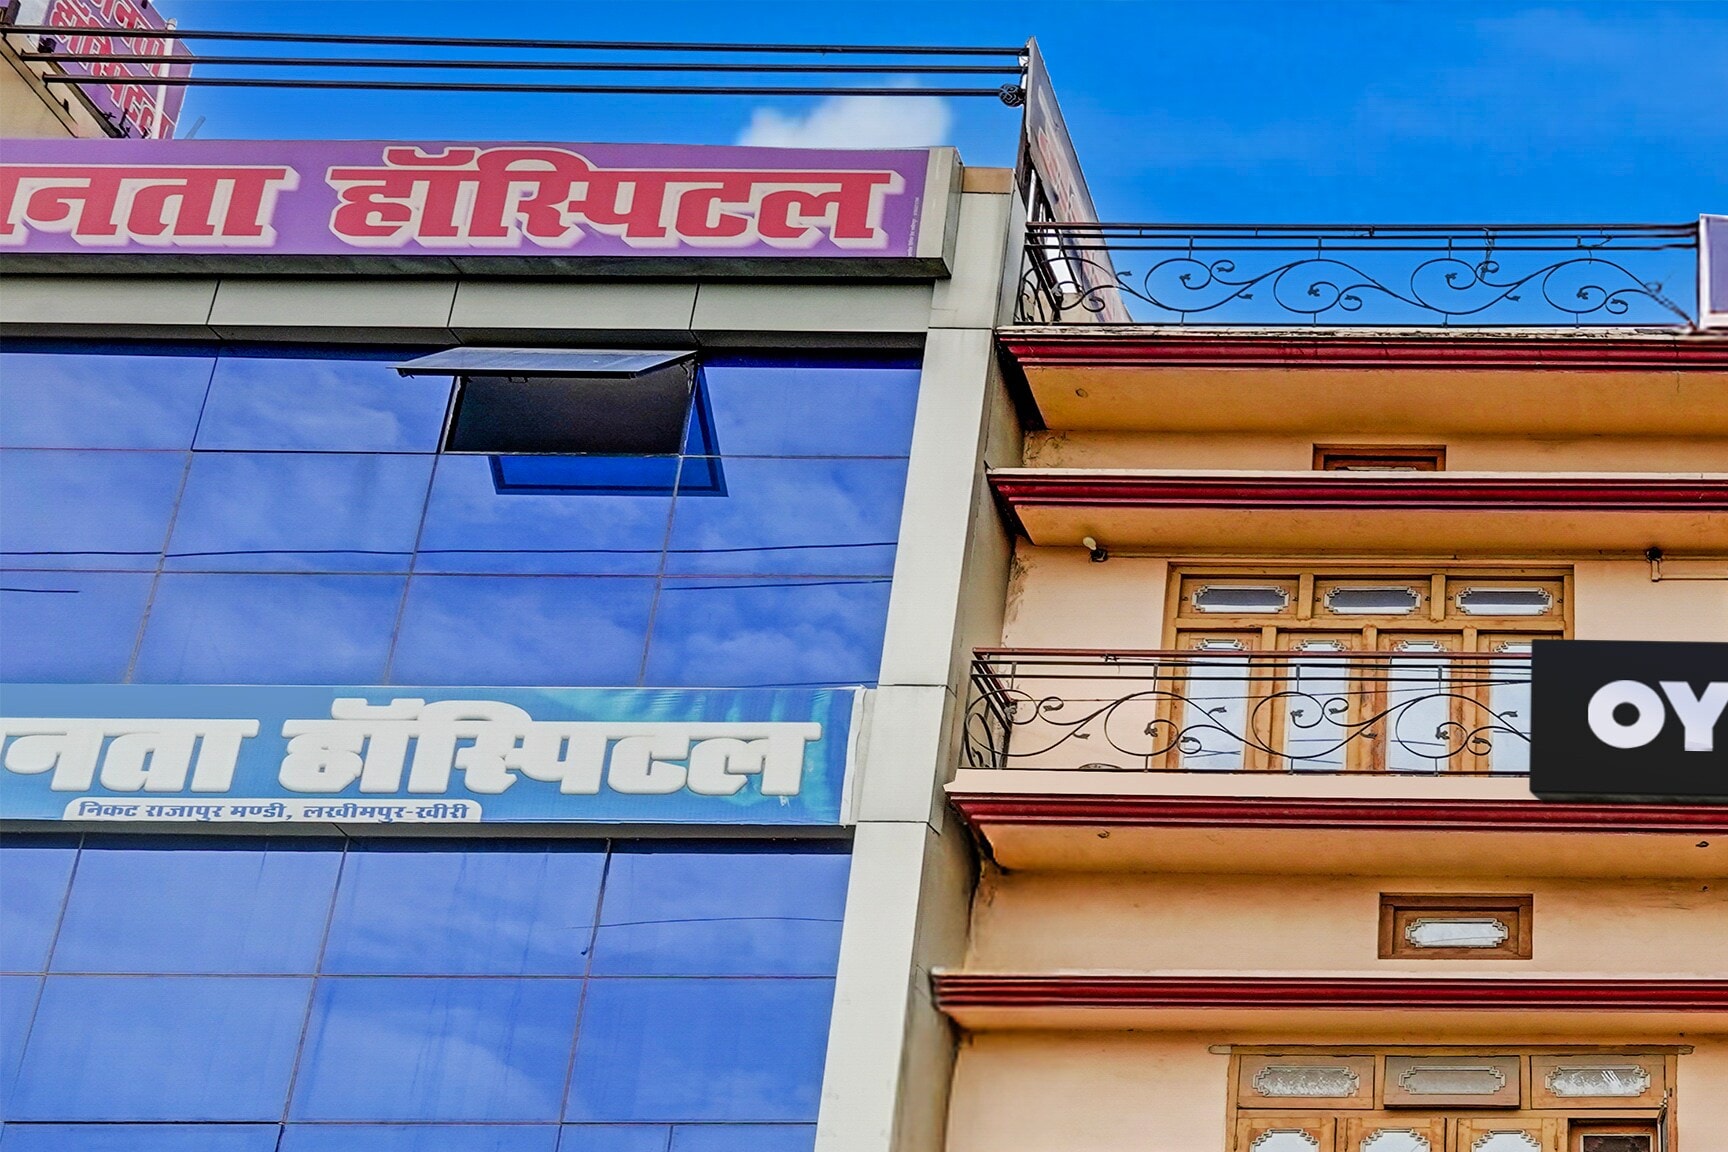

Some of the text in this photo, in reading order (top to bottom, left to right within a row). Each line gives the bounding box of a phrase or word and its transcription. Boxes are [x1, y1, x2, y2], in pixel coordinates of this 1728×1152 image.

[0, 165, 295, 242] नता
[328, 146, 903, 247] हॉस्पिटल
[0, 698, 822, 796] नता हॉस्पिटल
[78, 801, 141, 818] निकट
[145, 805, 223, 822] राजापुर
